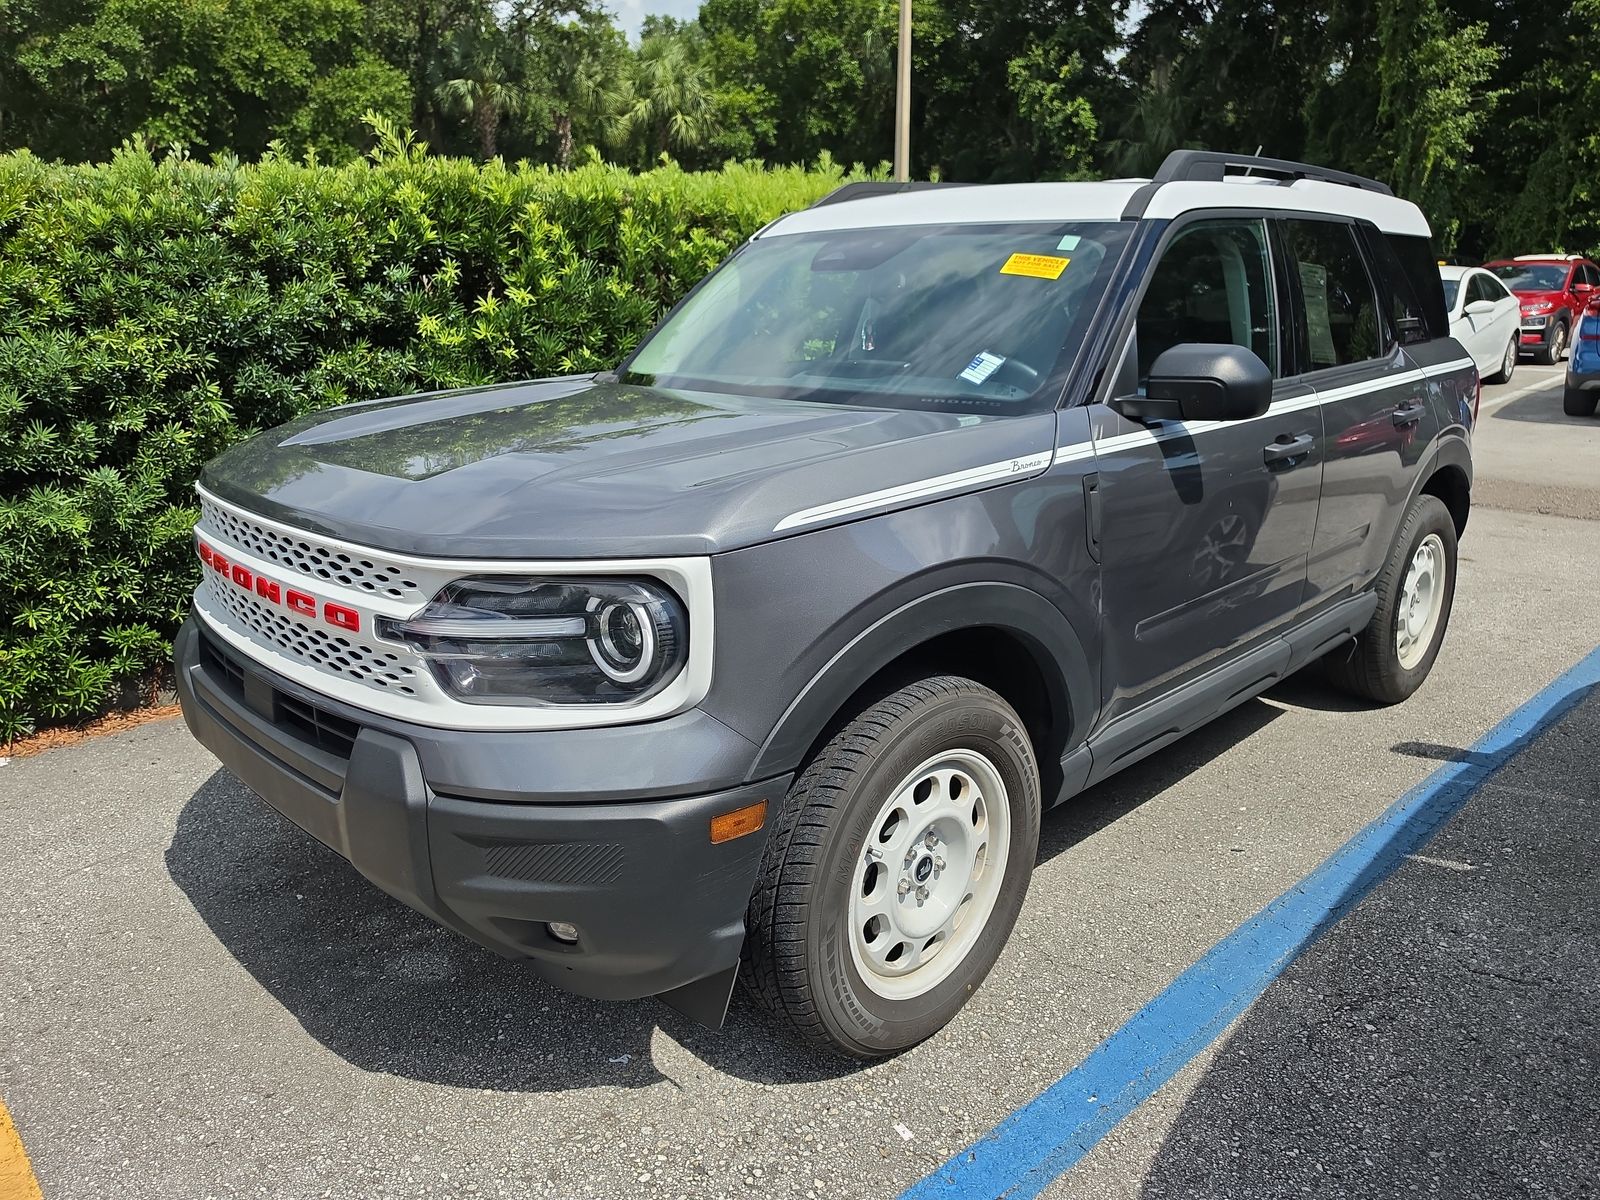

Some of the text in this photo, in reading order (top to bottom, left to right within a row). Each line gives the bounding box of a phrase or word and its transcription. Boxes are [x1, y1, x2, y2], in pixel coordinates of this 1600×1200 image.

[921, 398, 1001, 407] BRONCO
[1010, 460, 1043, 472] Bronco
[198, 542, 360, 633] BRONCO
[919, 713, 993, 746] SEASON
